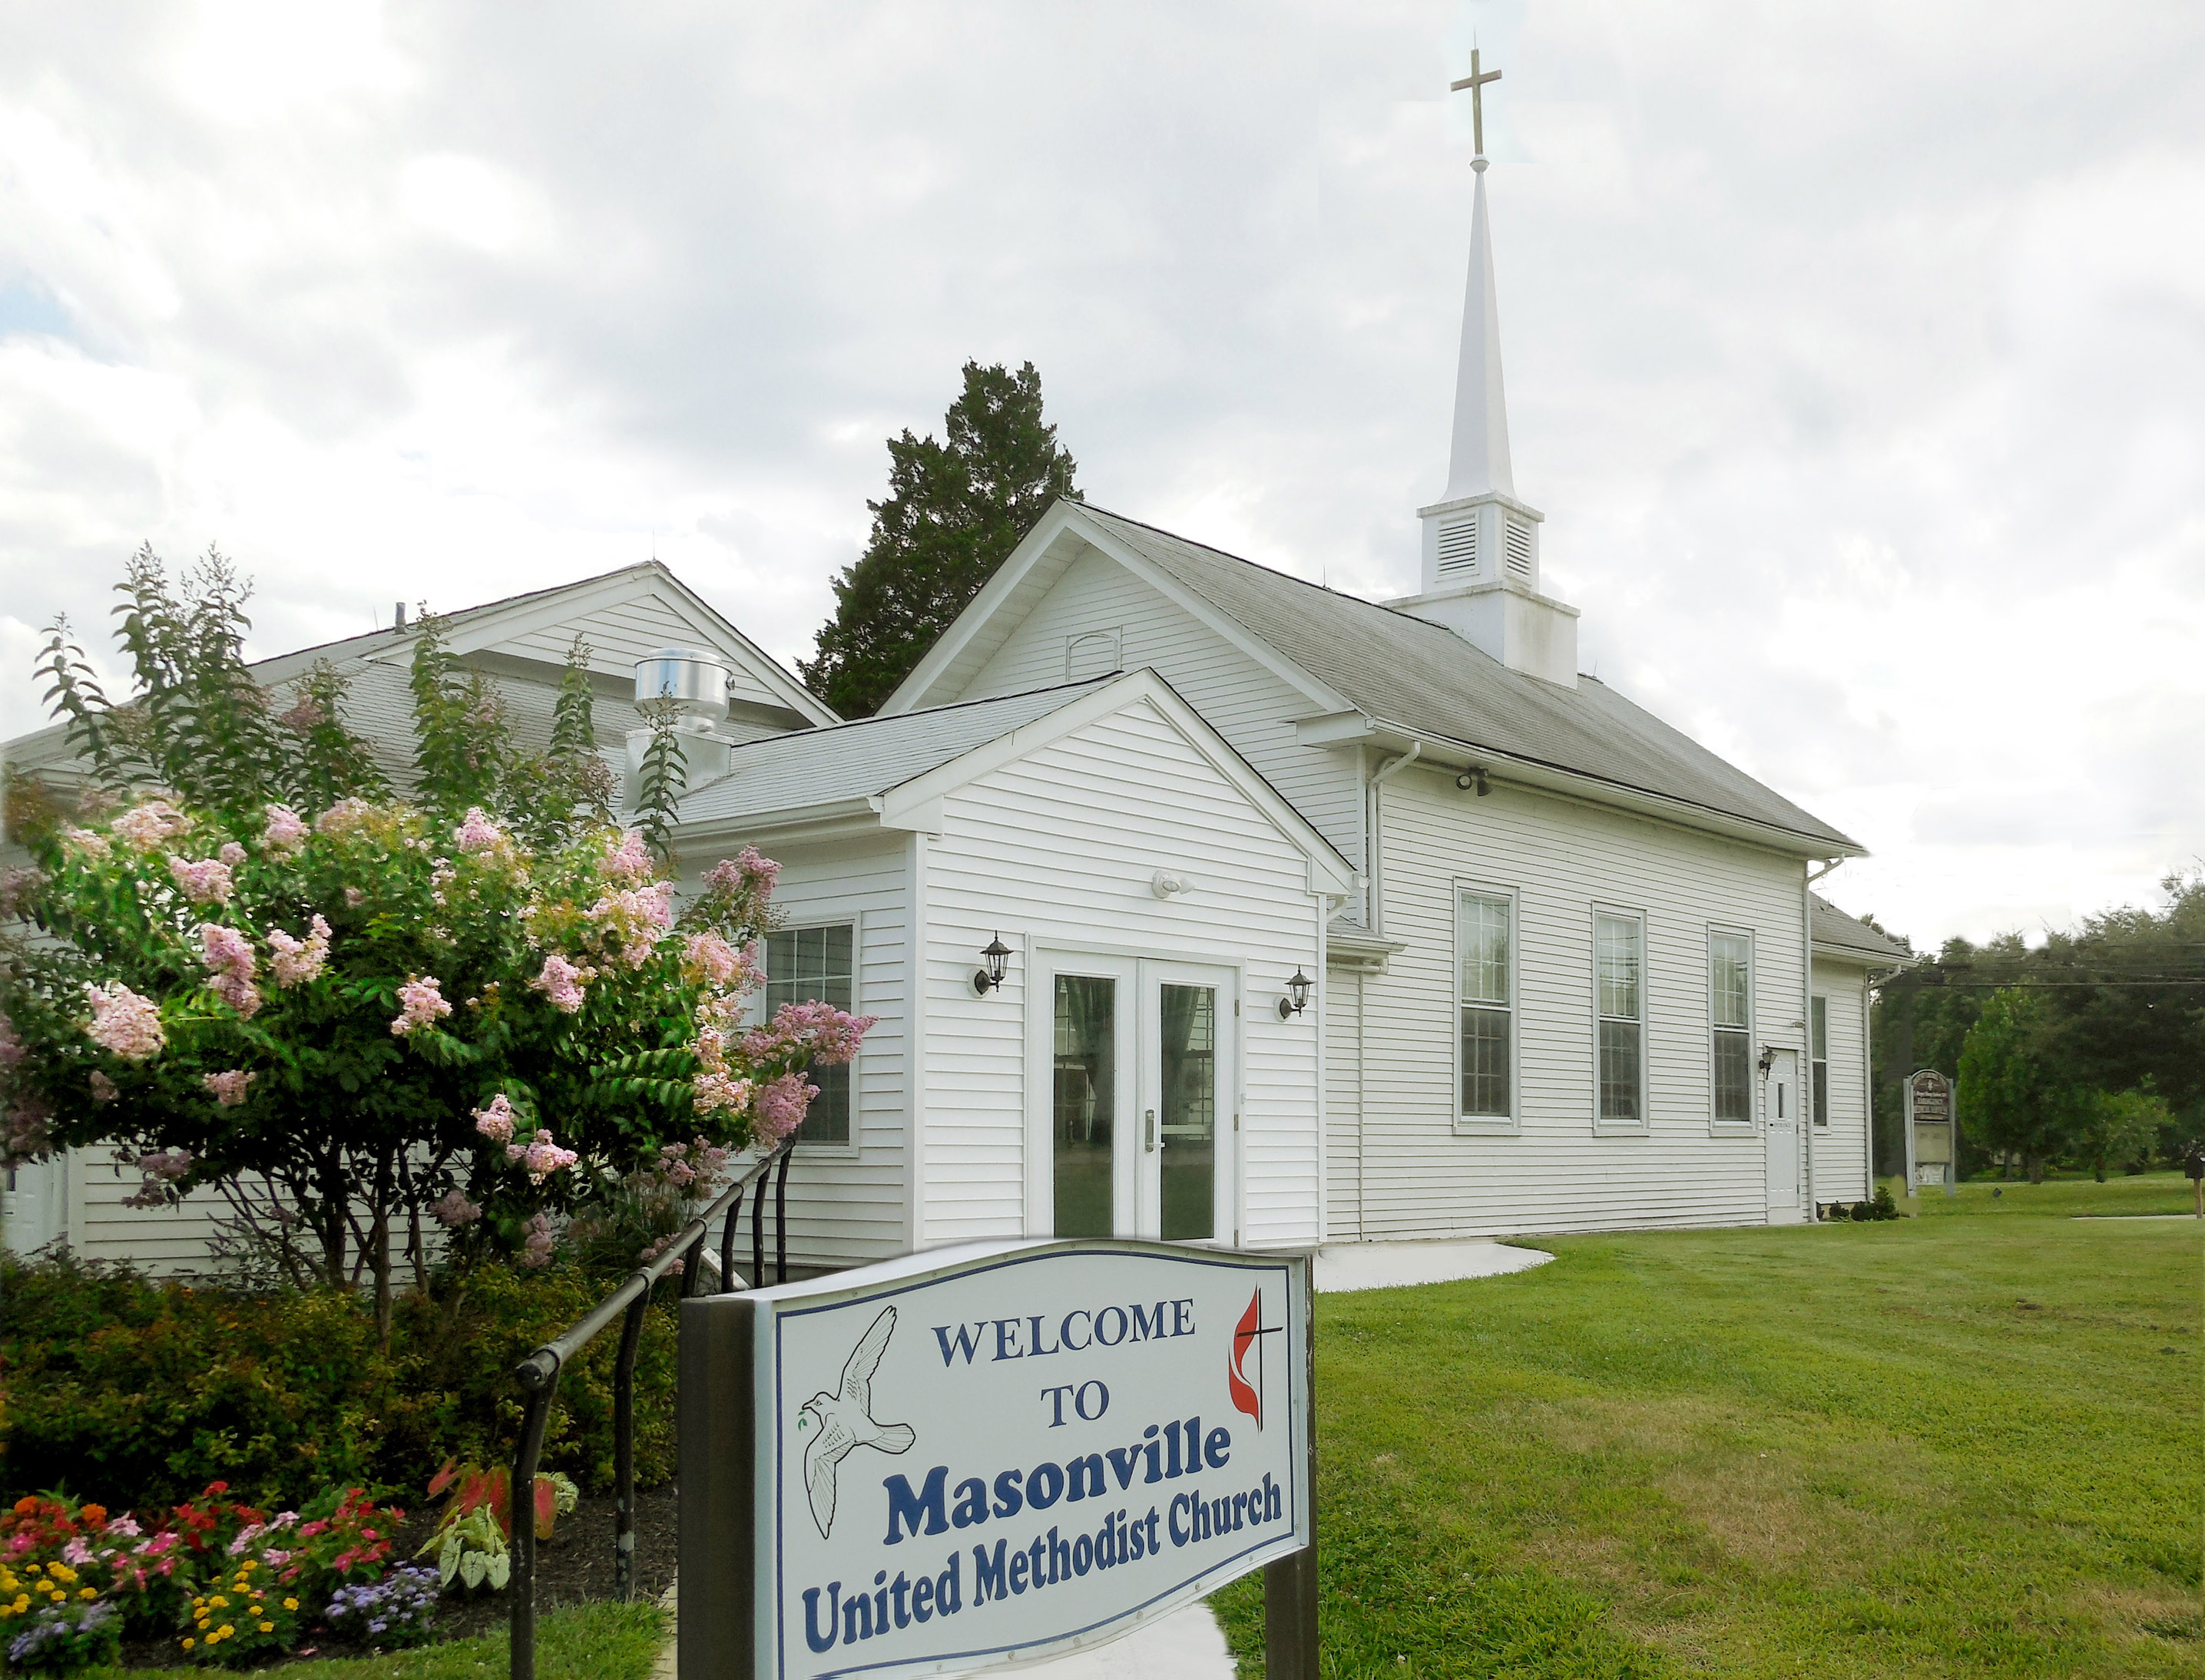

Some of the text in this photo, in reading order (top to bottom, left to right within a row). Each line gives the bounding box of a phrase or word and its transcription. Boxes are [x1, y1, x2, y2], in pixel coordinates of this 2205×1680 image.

[932, 1298, 1197, 1367] WELCOME
[1041, 1380, 1110, 1429] TO
[882, 1416, 1232, 1546] Masonville
[802, 1471, 1283, 1654] United Methodist Church
